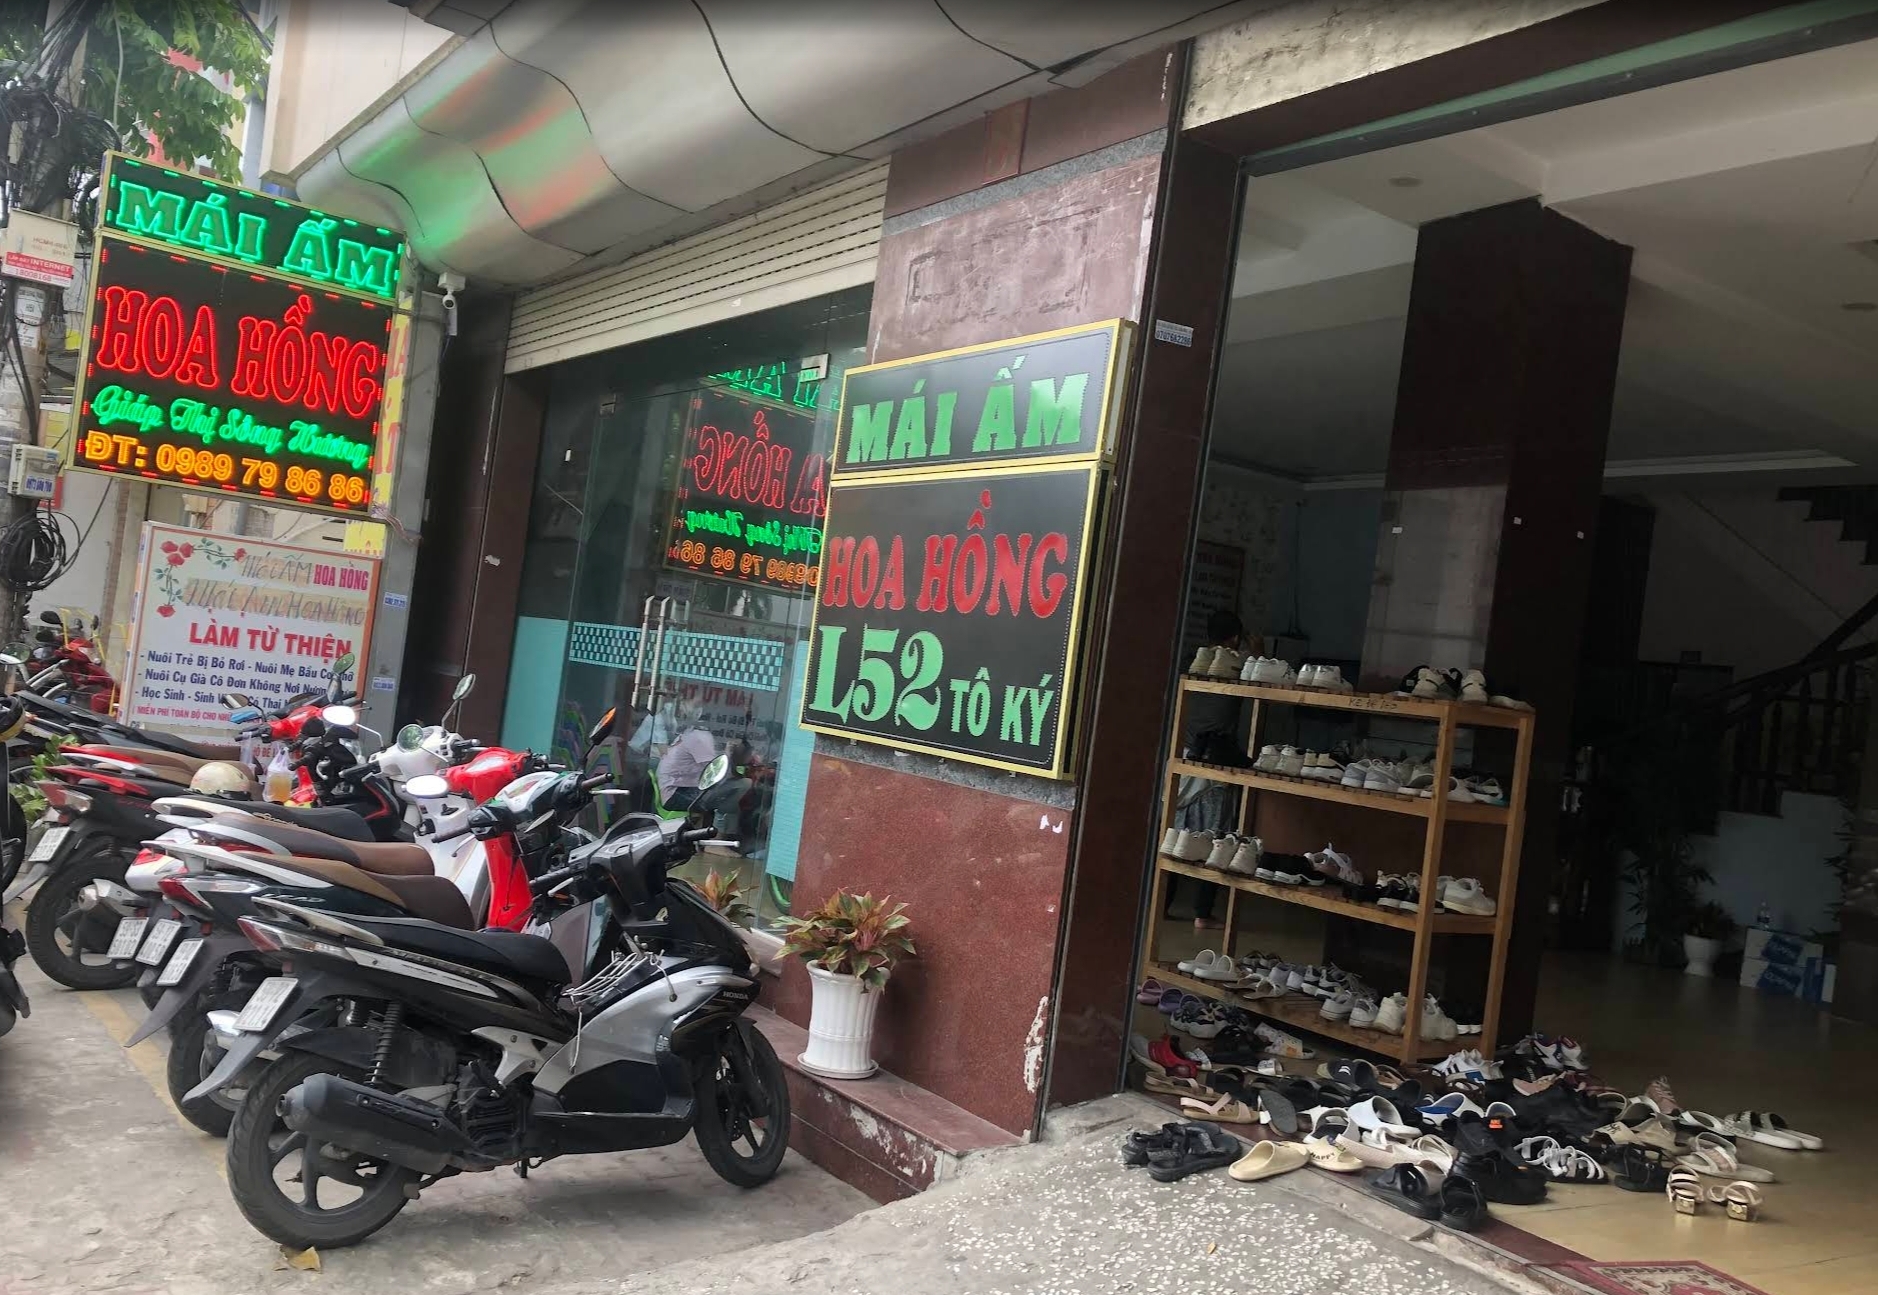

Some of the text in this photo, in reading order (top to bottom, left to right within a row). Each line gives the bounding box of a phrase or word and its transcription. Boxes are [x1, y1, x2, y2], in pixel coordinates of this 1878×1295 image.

[30, 259, 71, 272] INTERNET
[116, 181, 396, 297] MÁI ẤM
[97, 286, 219, 389] HOA
[231, 294, 382, 417] HỒNG
[90, 385, 164, 432] Giáp
[170, 398, 216, 444] Thị
[219, 408, 283, 454] Sông
[288, 420, 369, 470] Hương
[846, 379, 958, 464] MÁI
[972, 355, 1090, 454] ẤM
[85, 430, 365, 503] ĐT: 0989 79 86 86
[313, 563, 336, 587] HOA
[822, 534, 905, 610] HOA
[917, 489, 1068, 618] HỒNG
[147, 650, 172, 664] Nuôi
[175, 652, 194, 666] Trẻ
[197, 655, 208, 670] Bị
[211, 656, 225, 669] Bỏ
[228, 658, 245, 671] Rơi
[254, 661, 278, 674] Nuôi
[279, 664, 295, 676] Mẹ
[189, 618, 351, 664] LÀM TỪ THIỆN
[141, 686, 161, 701] Học
[163, 688, 185, 701] Sinh
[194, 690, 215, 704] Sinh
[262, 697, 282, 710] Thai
[145, 668, 170, 681] Nuôi
[172, 671, 187, 685] Cụ
[190, 672, 207, 685] Già
[210, 674, 224, 686] Cô
[226, 676, 246, 689] Đơn
[249, 678, 281, 694] Không
[284, 681, 300, 694] Nơi
[809, 623, 943, 731] L52
[950, 666, 990, 737] TÔ
[1000, 673, 1054, 746] KÝ
[722, 991, 749, 1000] HONDA
